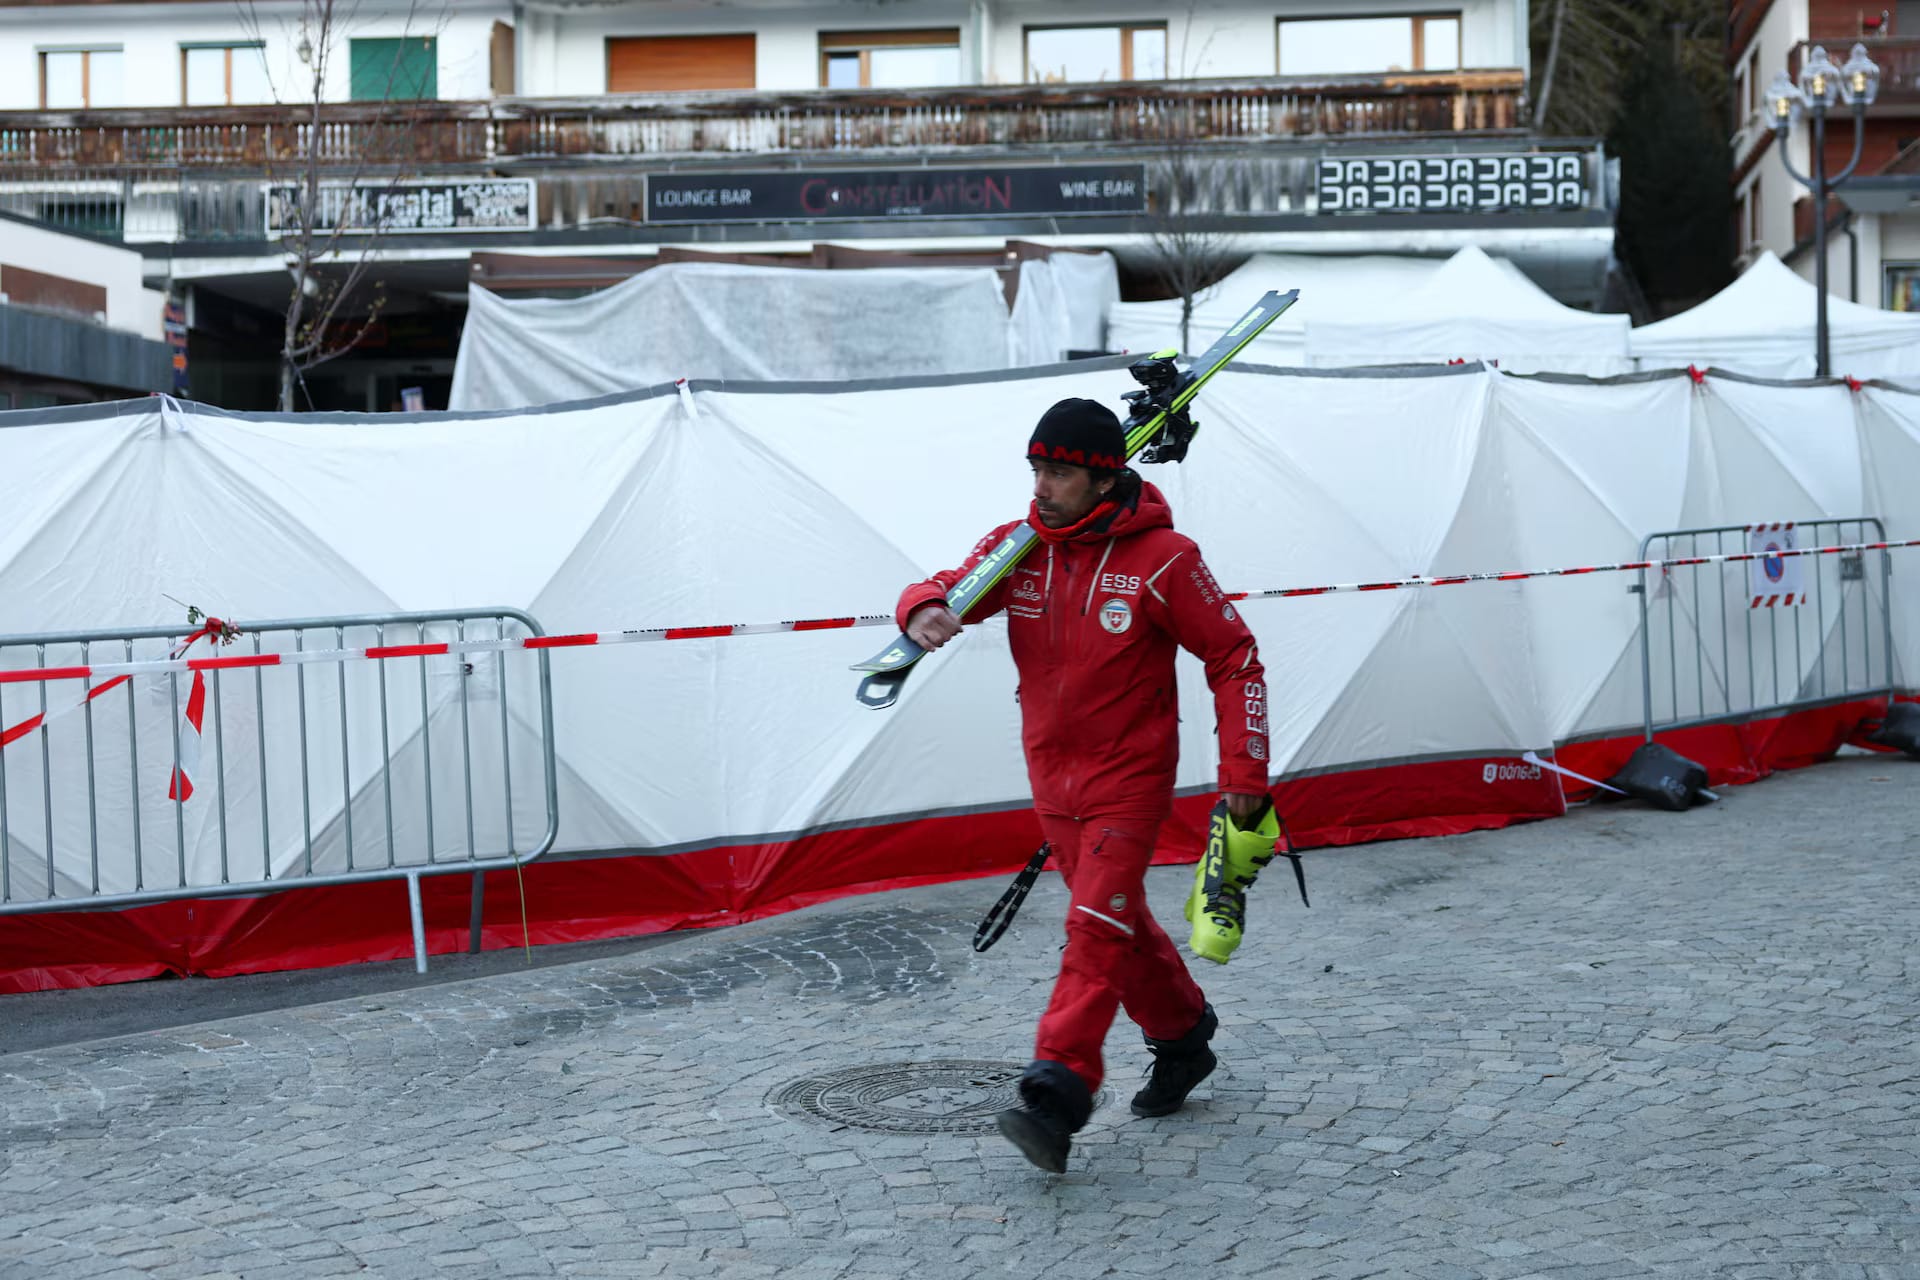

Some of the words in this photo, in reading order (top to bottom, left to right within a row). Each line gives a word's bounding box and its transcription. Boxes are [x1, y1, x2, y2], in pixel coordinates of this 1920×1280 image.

[656, 189, 718, 207] LOUNGE
[720, 188, 752, 206] BAR
[1059, 180, 1101, 198] WINE
[1103, 179, 1136, 197] BAR
[378, 188, 454, 217] rental
[947, 538, 1016, 608] FISCH
[1101, 573, 1141, 590] ESS
[1244, 682, 1263, 734] ESS
